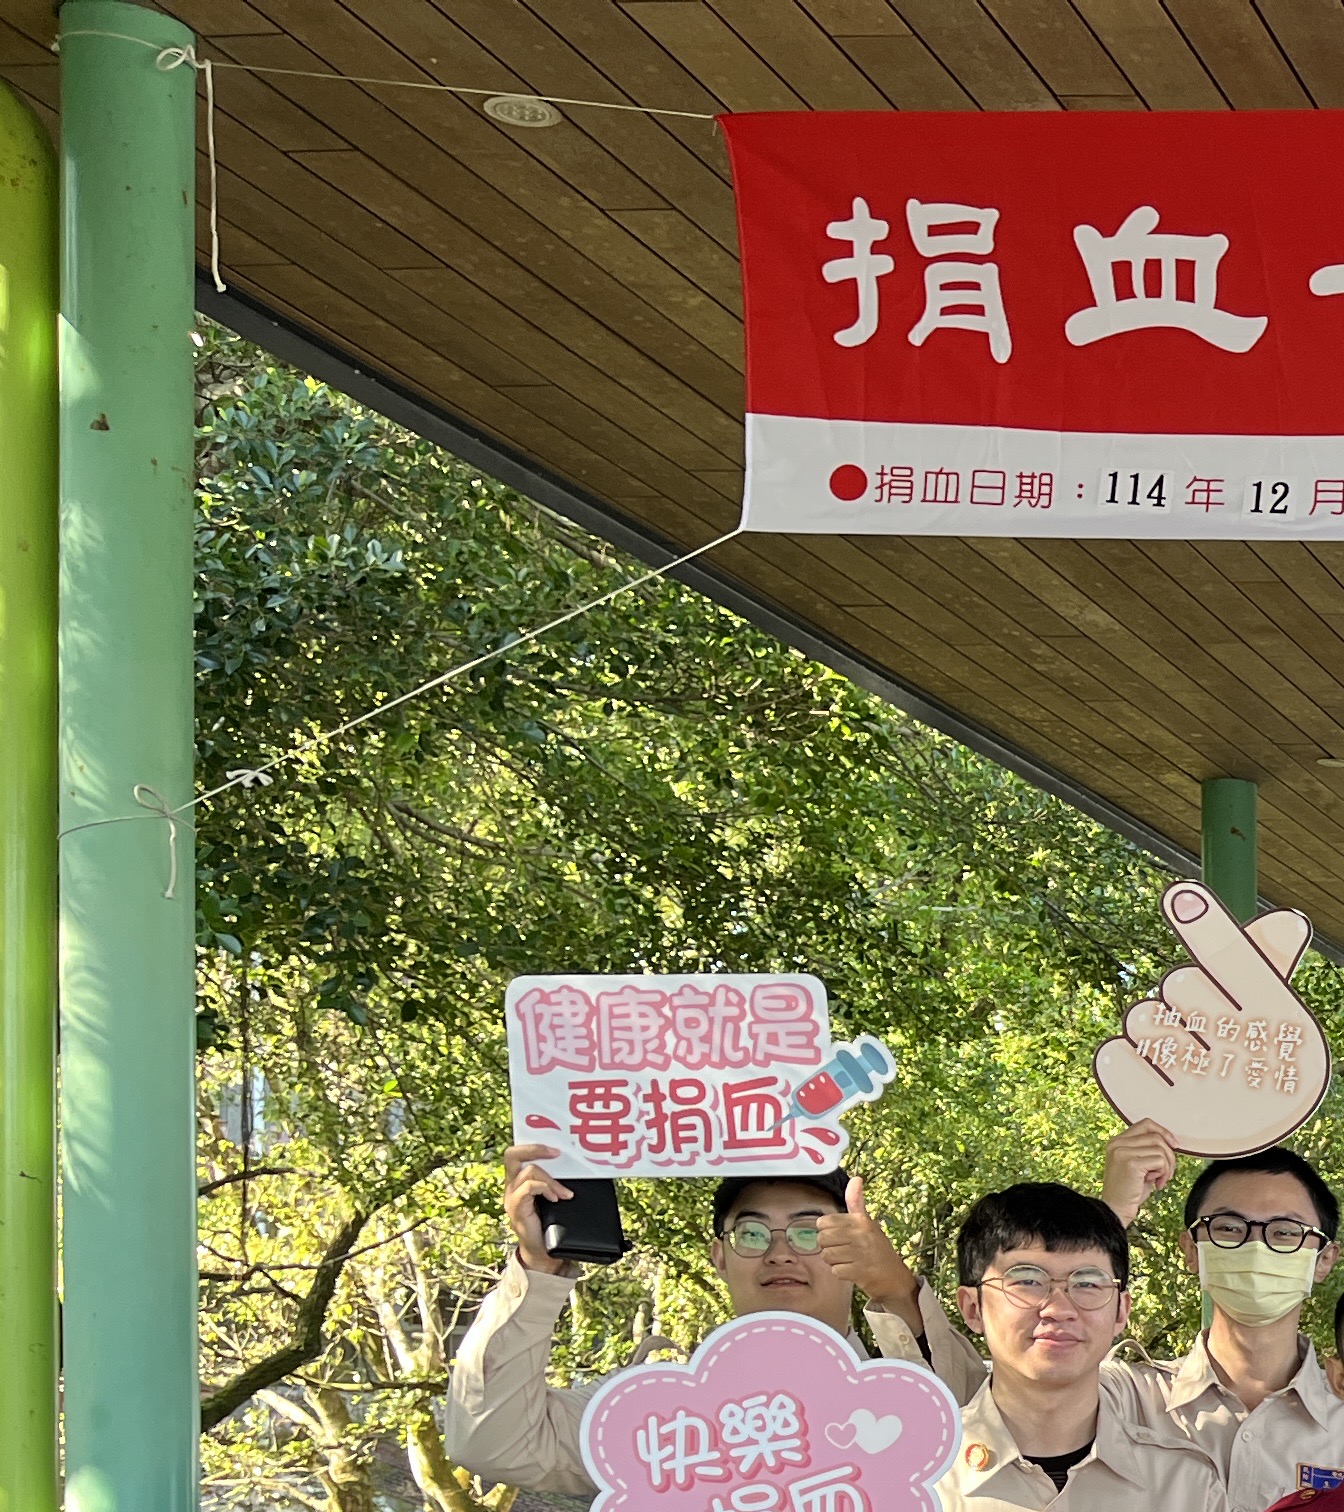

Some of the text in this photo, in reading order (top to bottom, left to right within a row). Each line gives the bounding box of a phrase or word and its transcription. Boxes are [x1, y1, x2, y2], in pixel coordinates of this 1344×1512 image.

[1105, 470, 1169, 509] 114
[1185, 475, 1226, 513] 年
[1250, 480, 1291, 515] 12
[516, 983, 822, 1074] 健康就是
[1153, 1003, 1303, 1062] 抽血的感覺
[567, 1076, 787, 1156] 要捐血
[636, 1394, 802, 1487] 快樂
